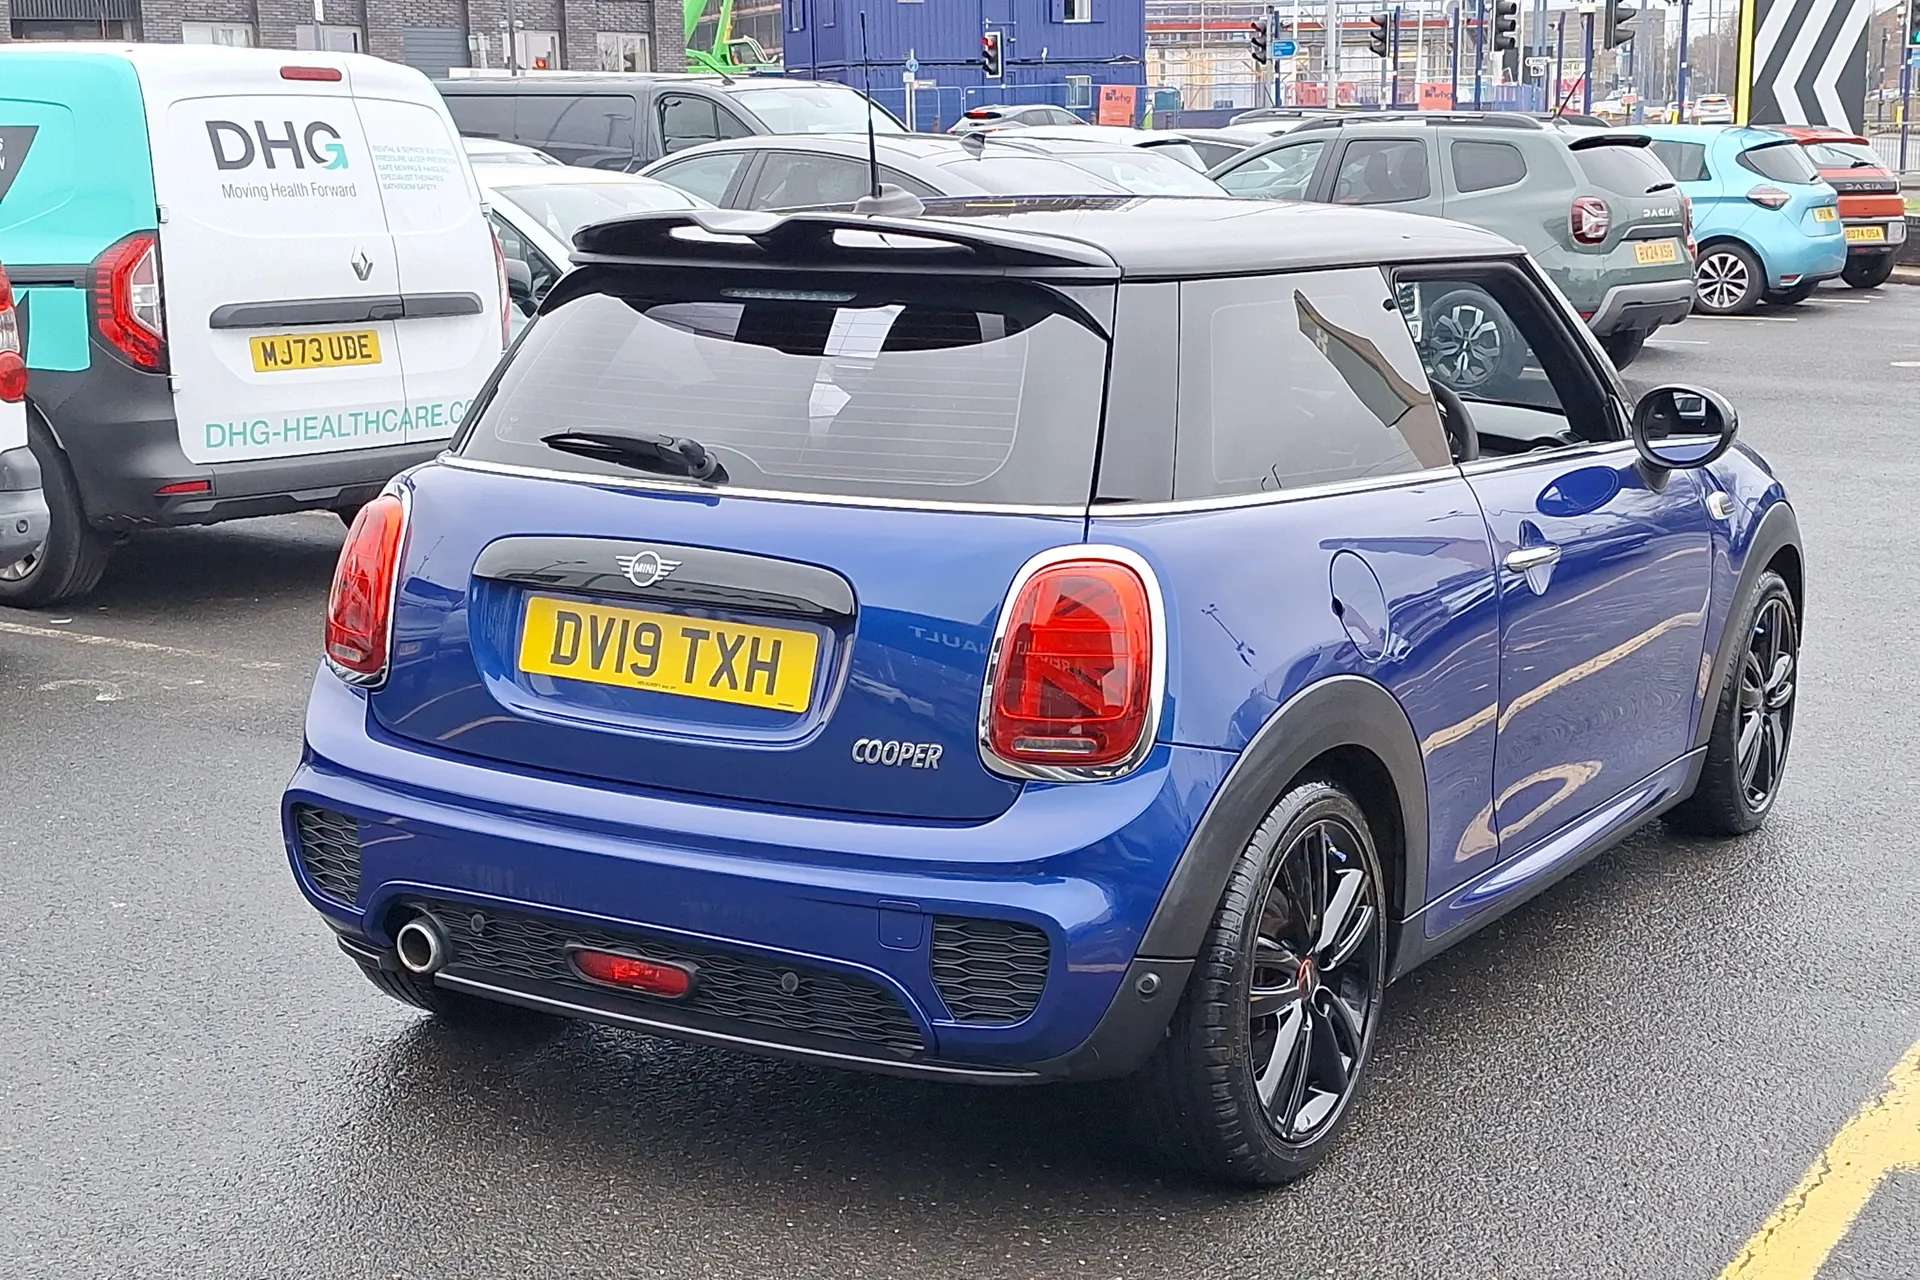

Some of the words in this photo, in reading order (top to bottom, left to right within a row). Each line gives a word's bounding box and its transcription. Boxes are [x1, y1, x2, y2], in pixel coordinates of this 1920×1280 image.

[205, 120, 349, 170] DHG
[221, 183, 268, 201] Moving
[270, 183, 308, 198] Health
[310, 182, 357, 197] Forward
[1642, 208, 1674, 217] DACIA
[260, 338, 324, 367] MJ73
[328, 335, 372, 361] UDE
[633, 562, 656, 574] MINI
[550, 610, 662, 677] DV19
[680, 627, 782, 695] TXH
[851, 738, 944, 770] COOPER
